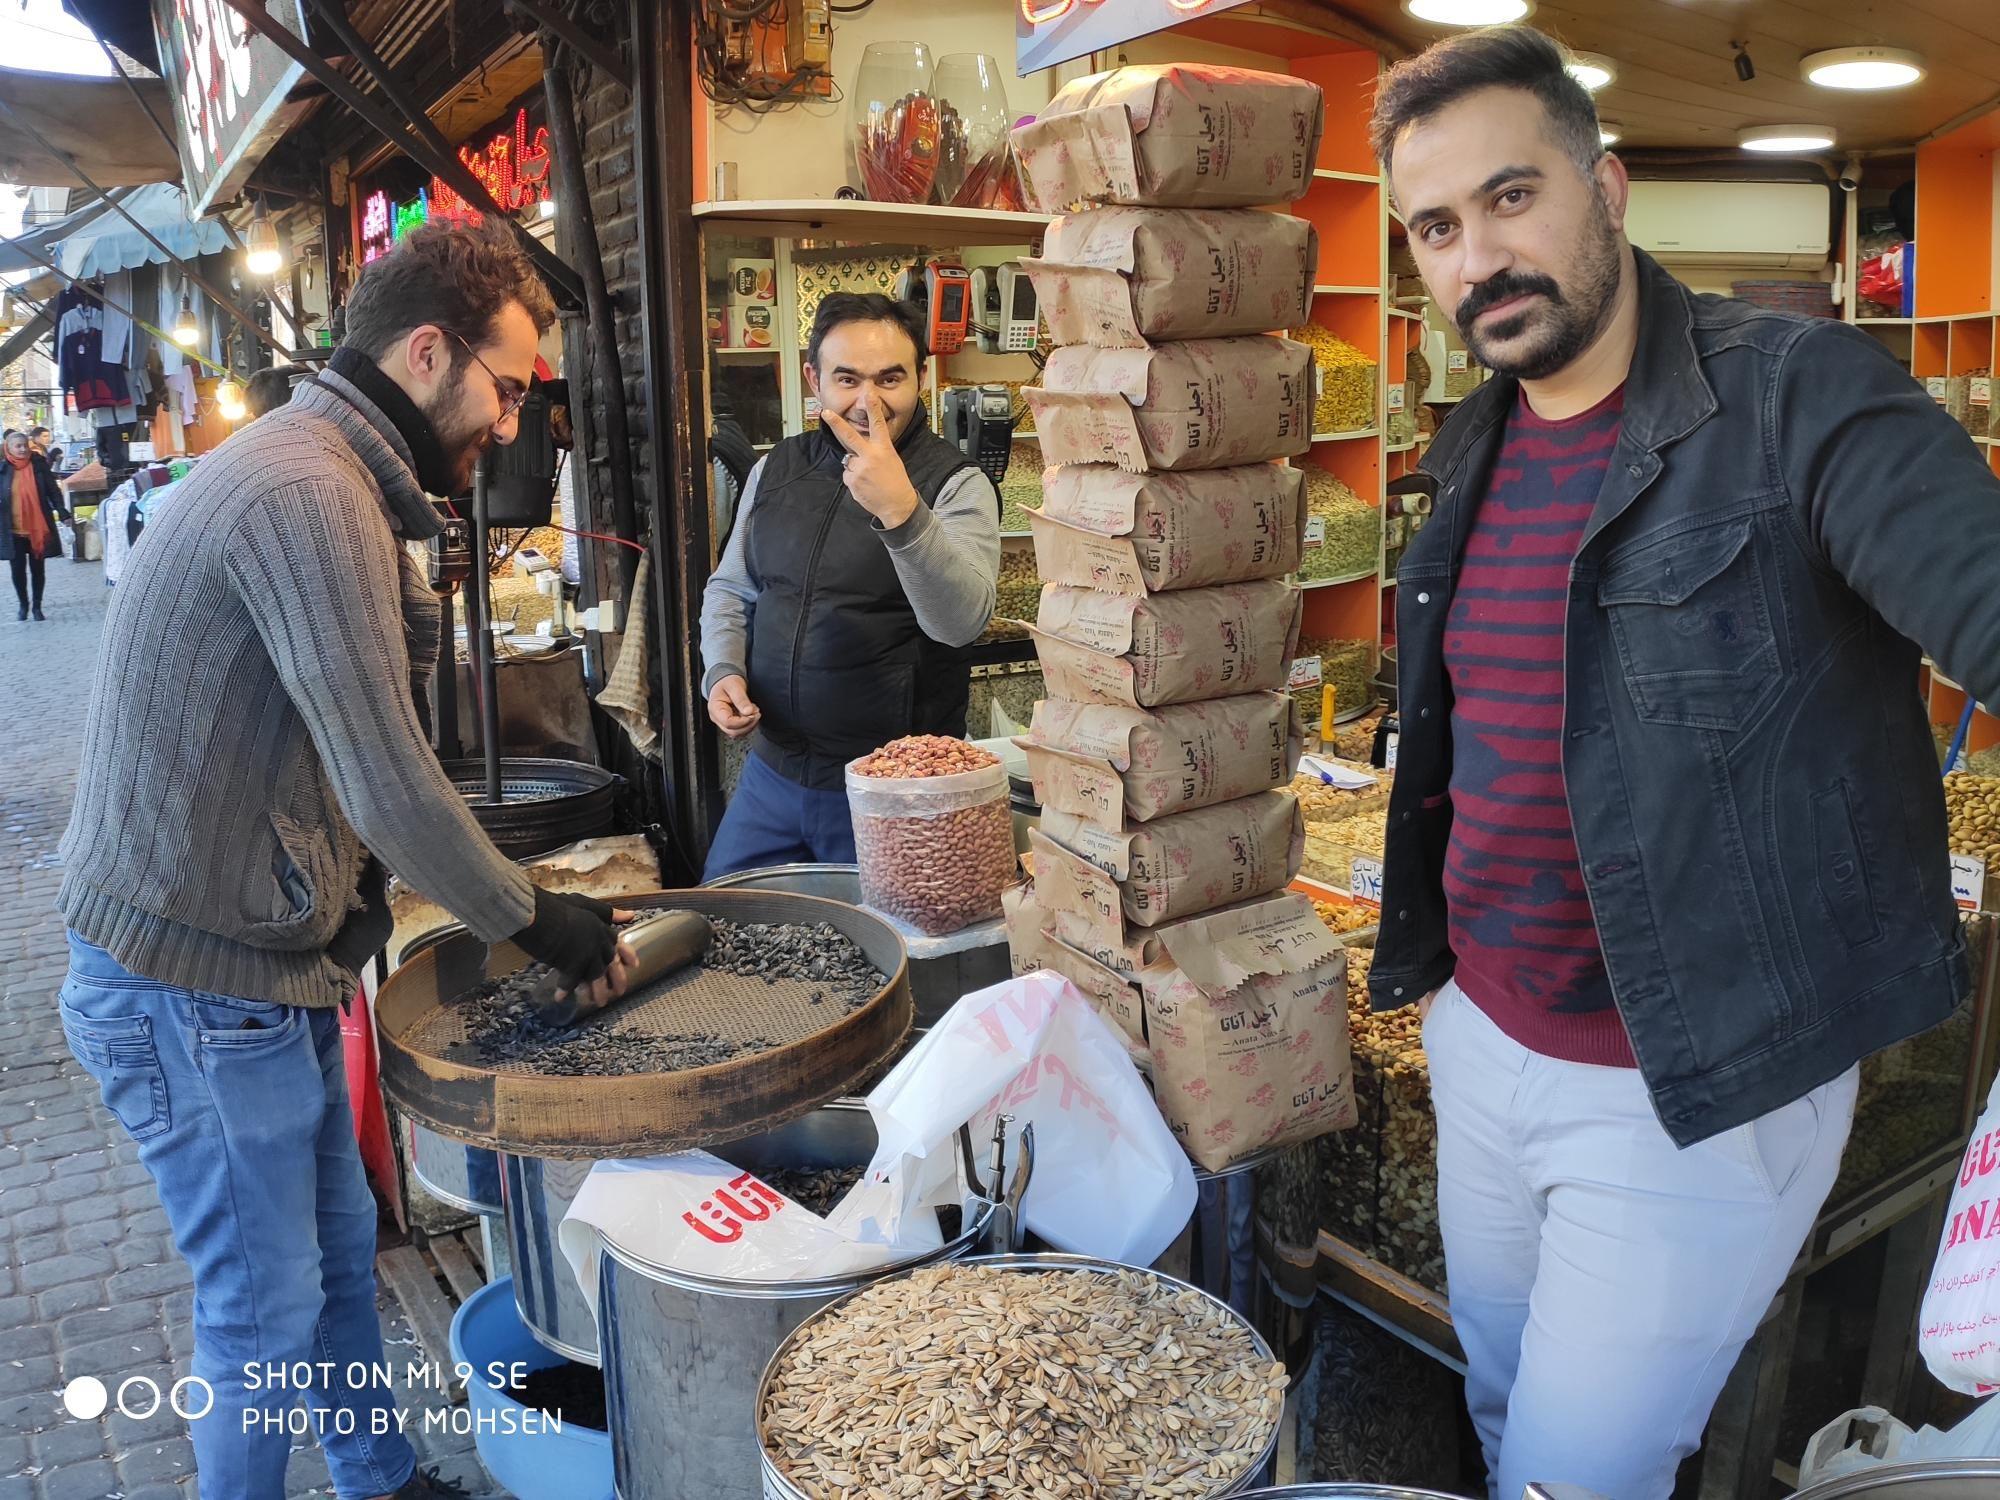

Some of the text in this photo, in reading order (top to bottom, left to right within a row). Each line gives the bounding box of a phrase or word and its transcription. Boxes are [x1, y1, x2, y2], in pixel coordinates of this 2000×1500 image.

[1196, 104, 1215, 176] آجیل آناتا
[1206, 246, 1225, 314] آجیل آناتا
[1186, 381, 1204, 448] آجیل آناتا
[1277, 372, 1293, 437] آجیل آناتا
[1146, 546, 1161, 573] آناتا
[1252, 501, 1268, 563] آجیل آناتا
[1220, 619, 1238, 682] آجیل آناتا
[1180, 740, 1198, 801] آجیل آناتا
[1131, 852, 1150, 910] آجیل آناتا
[1229, 834, 1247, 893] آجیل آناتا
[1157, 1000, 1179, 1018] آجیل
[1220, 1002, 1279, 1032] آجیل آناتا
[1292, 975, 1341, 999] Anata Nuts
[1231, 1034, 1258, 1047] Anata
[1292, 1086, 1316, 1108] آناتا
[682, 1172, 785, 1244] آناتا
